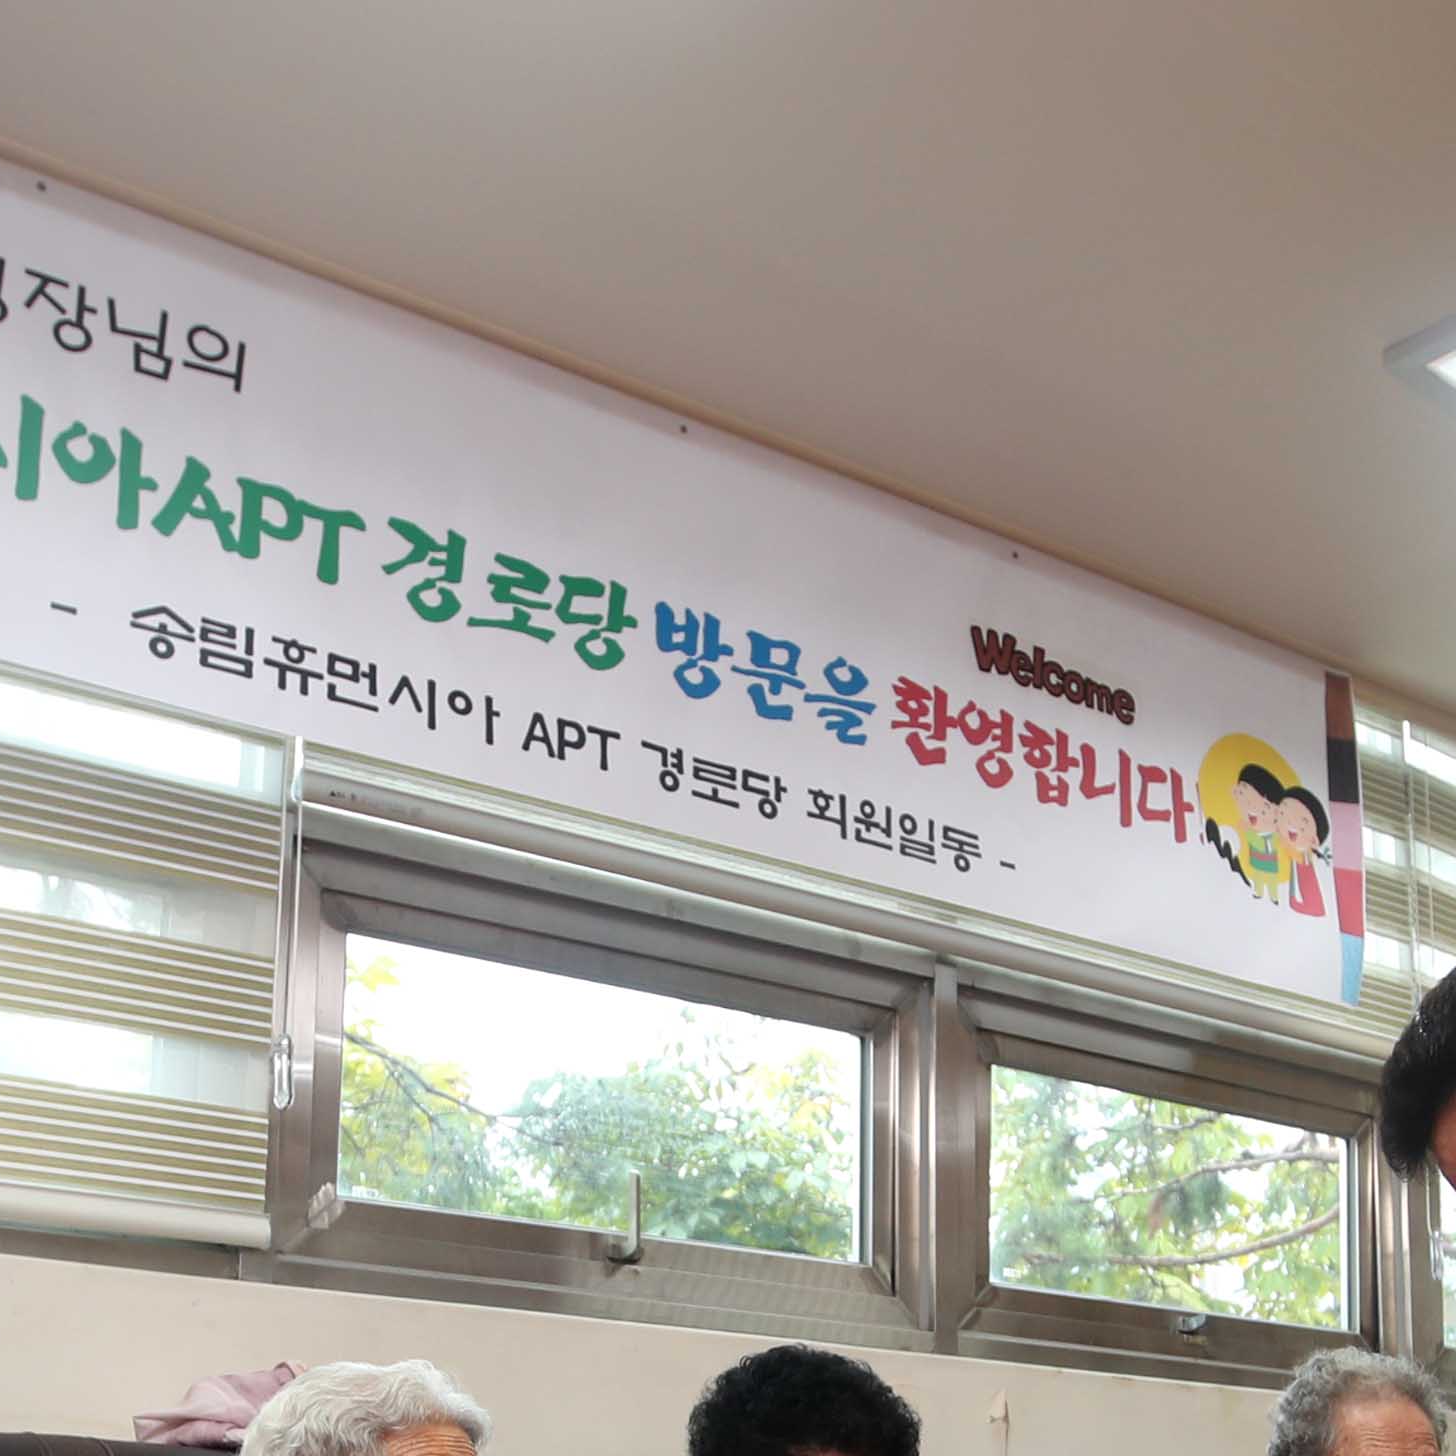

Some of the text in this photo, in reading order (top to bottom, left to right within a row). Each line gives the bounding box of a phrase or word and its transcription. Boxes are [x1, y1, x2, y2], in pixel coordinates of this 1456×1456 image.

[127, 603, 503, 748] 송림휴먼시아
[518, 710, 622, 774] APT
[636, 738, 788, 824] 경로당
[804, 785, 984, 874] 회원일동
[380, 514, 641, 673] 경로당
[653, 599, 879, 748] 방문을
[969, 624, 1137, 727] Welcome
